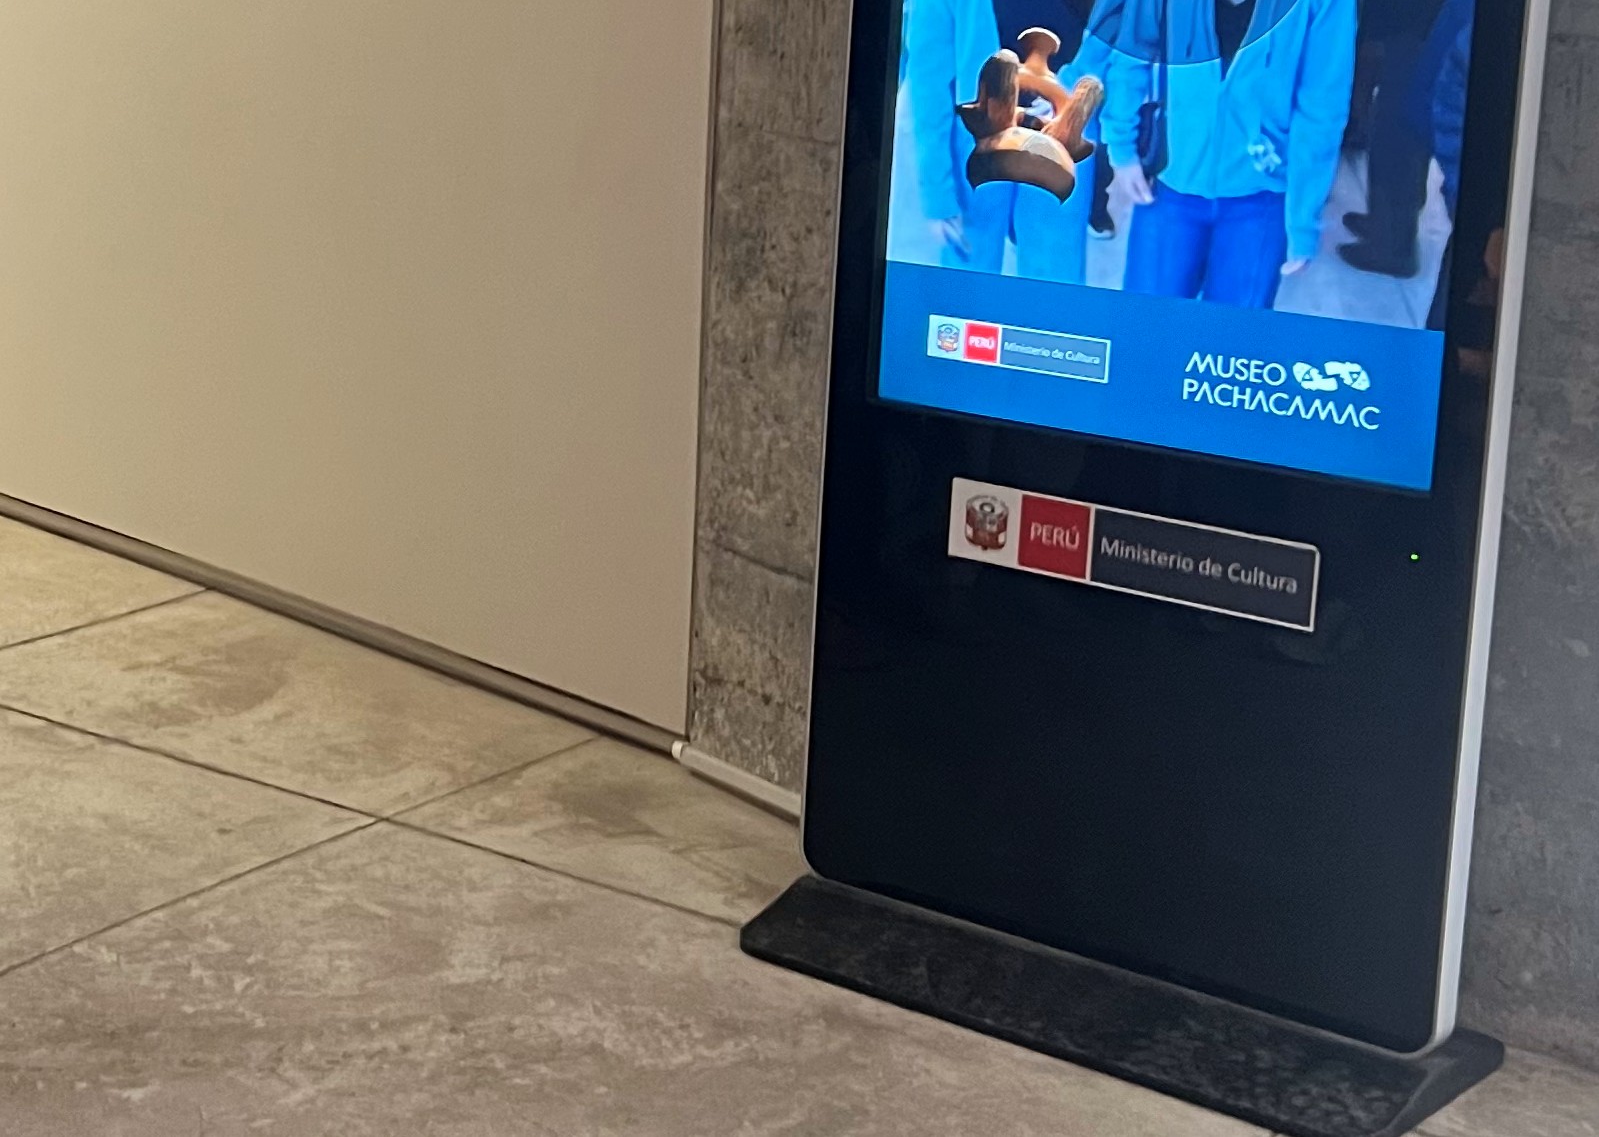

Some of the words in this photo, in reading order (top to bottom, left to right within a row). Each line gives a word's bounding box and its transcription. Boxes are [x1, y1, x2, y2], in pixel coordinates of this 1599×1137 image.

[967, 334, 996, 350] PERÚ
[1003, 341, 1051, 358] Ministerio
[1051, 348, 1064, 360] de
[1065, 350, 1100, 365] Cultura
[1185, 351, 1288, 387] MUSEO
[1182, 378, 1381, 430] PACHACAMAC
[1029, 520, 1080, 550] PERÚ
[1100, 536, 1195, 573] Ministerio
[1197, 556, 1223, 577] de
[1227, 561, 1298, 595] Cultura
